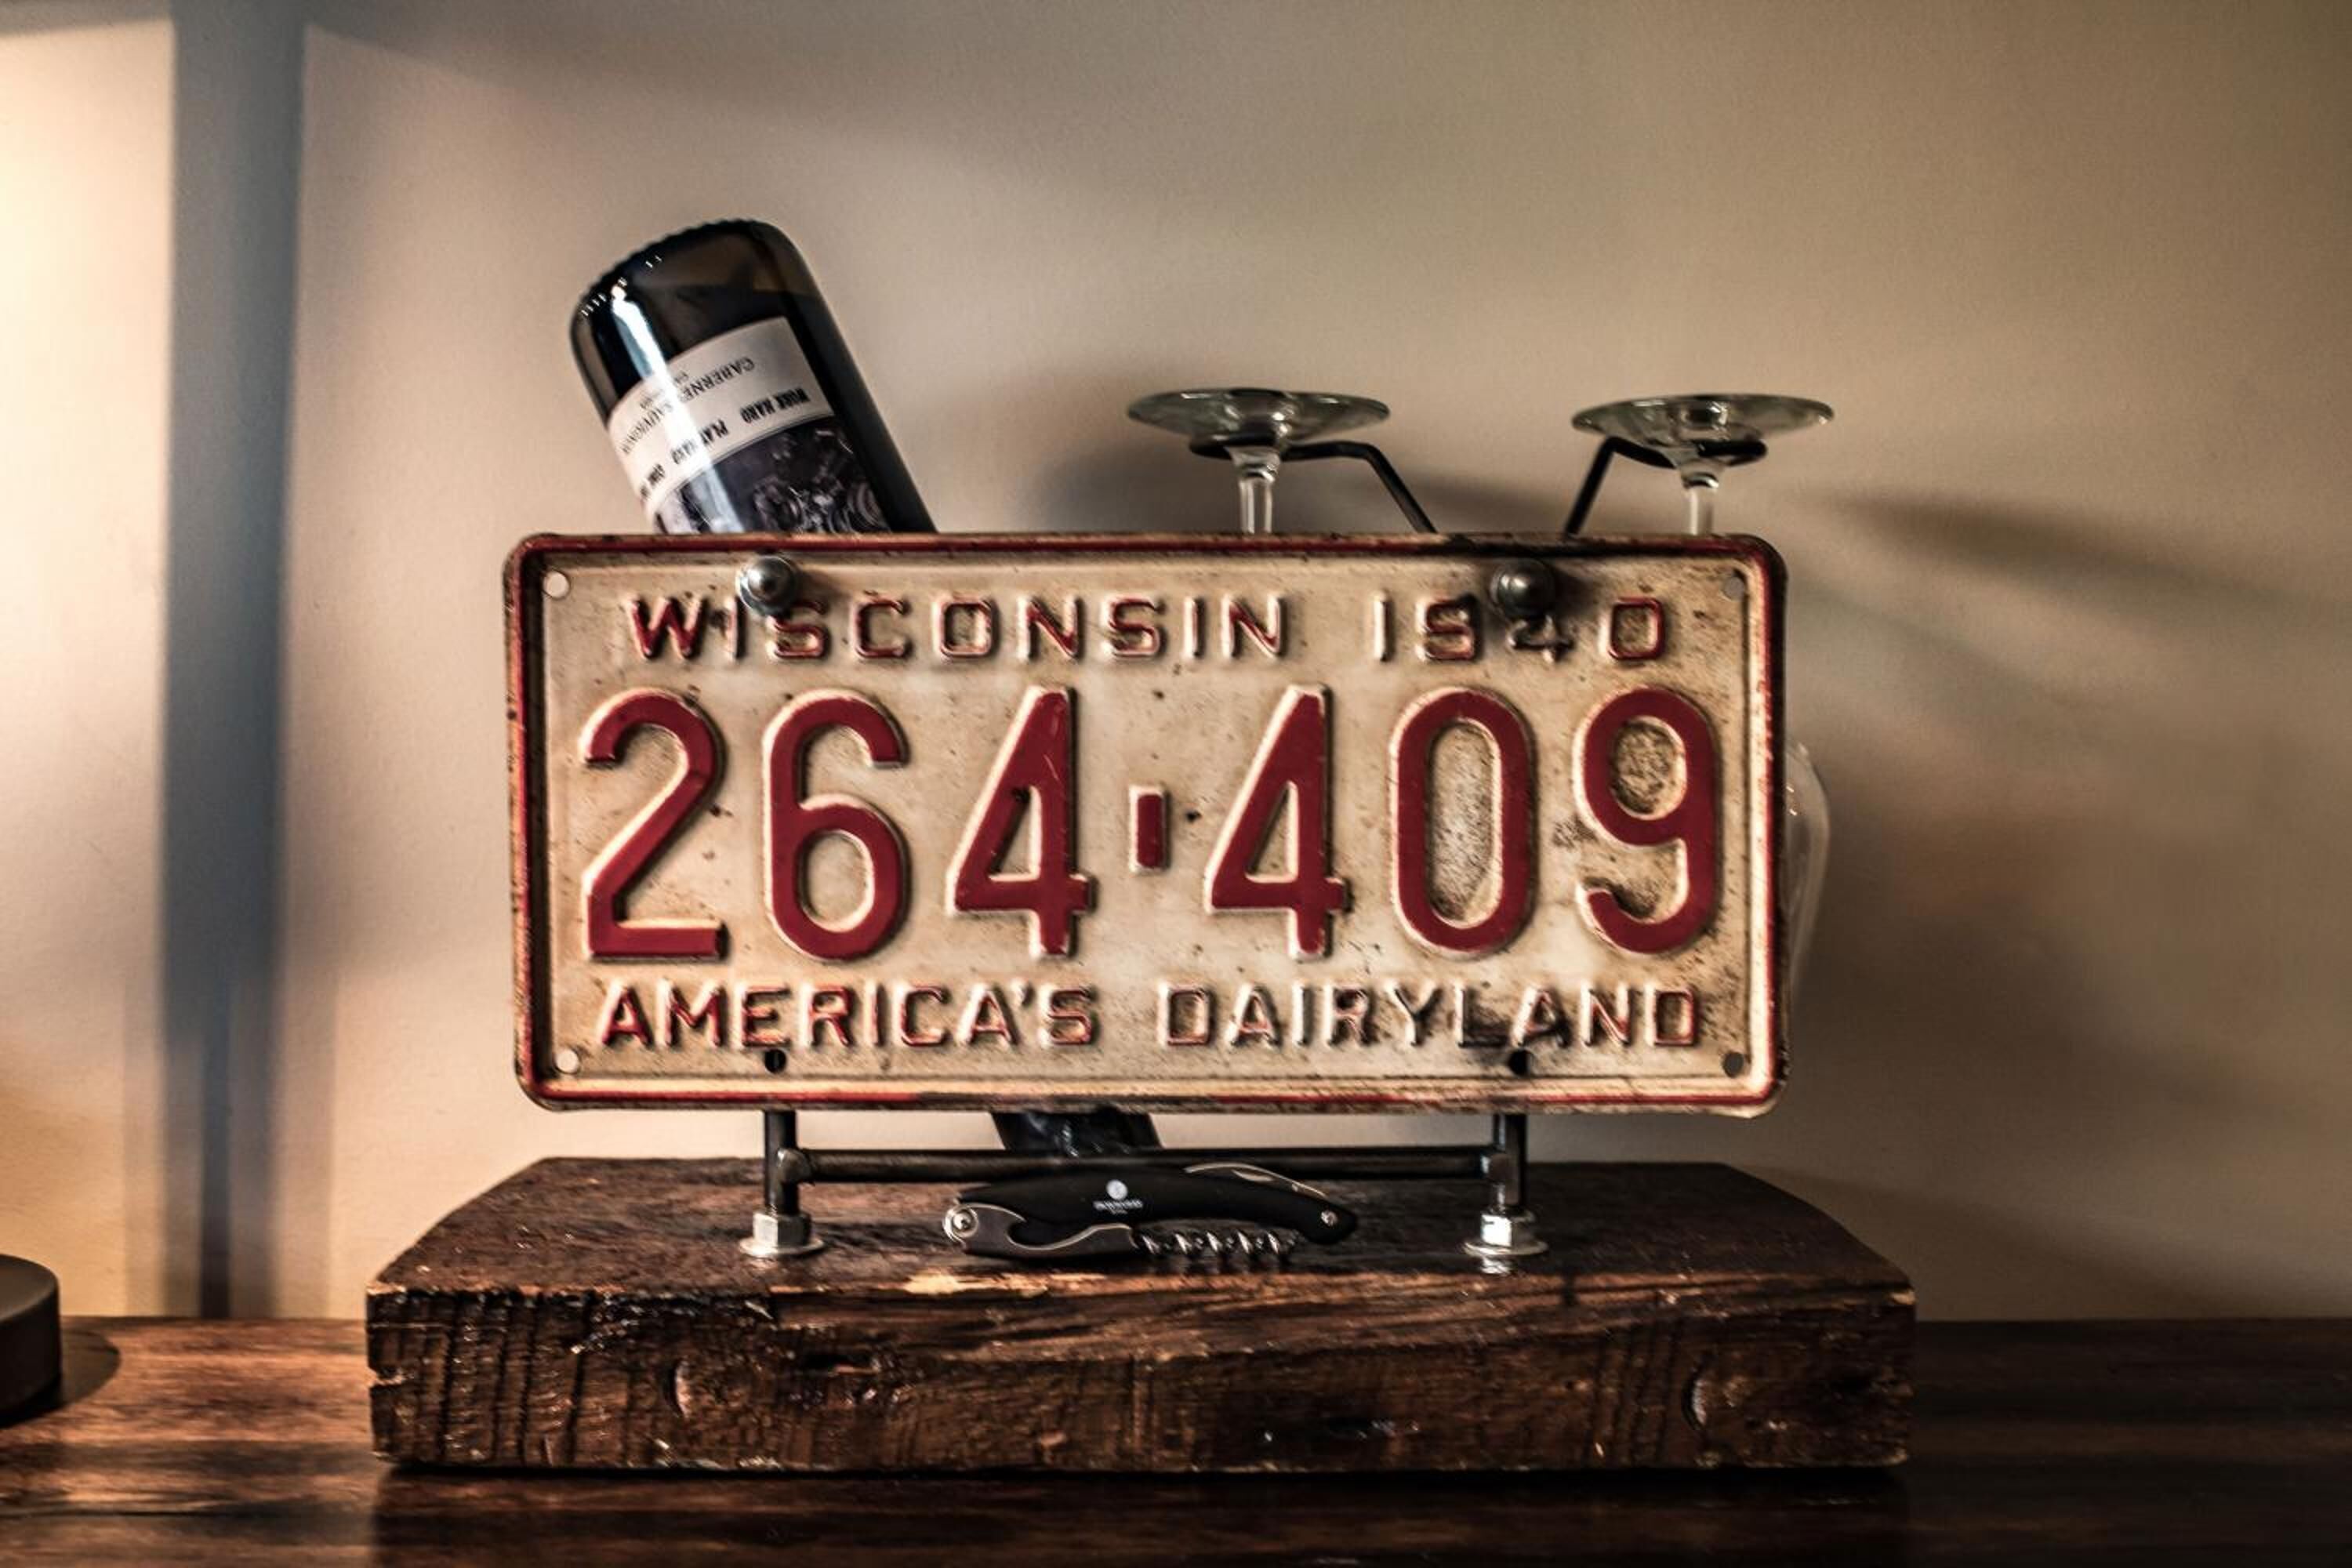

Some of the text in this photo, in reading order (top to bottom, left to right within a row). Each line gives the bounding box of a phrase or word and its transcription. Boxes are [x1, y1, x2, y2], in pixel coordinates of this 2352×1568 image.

[680, 356, 755, 403] CABERNE
[699, 418, 729, 447] PLAY
[628, 593, 1283, 659] WISCONSIN
[598, 980, 1699, 1049] AMERICA'S DAIRYLAND
